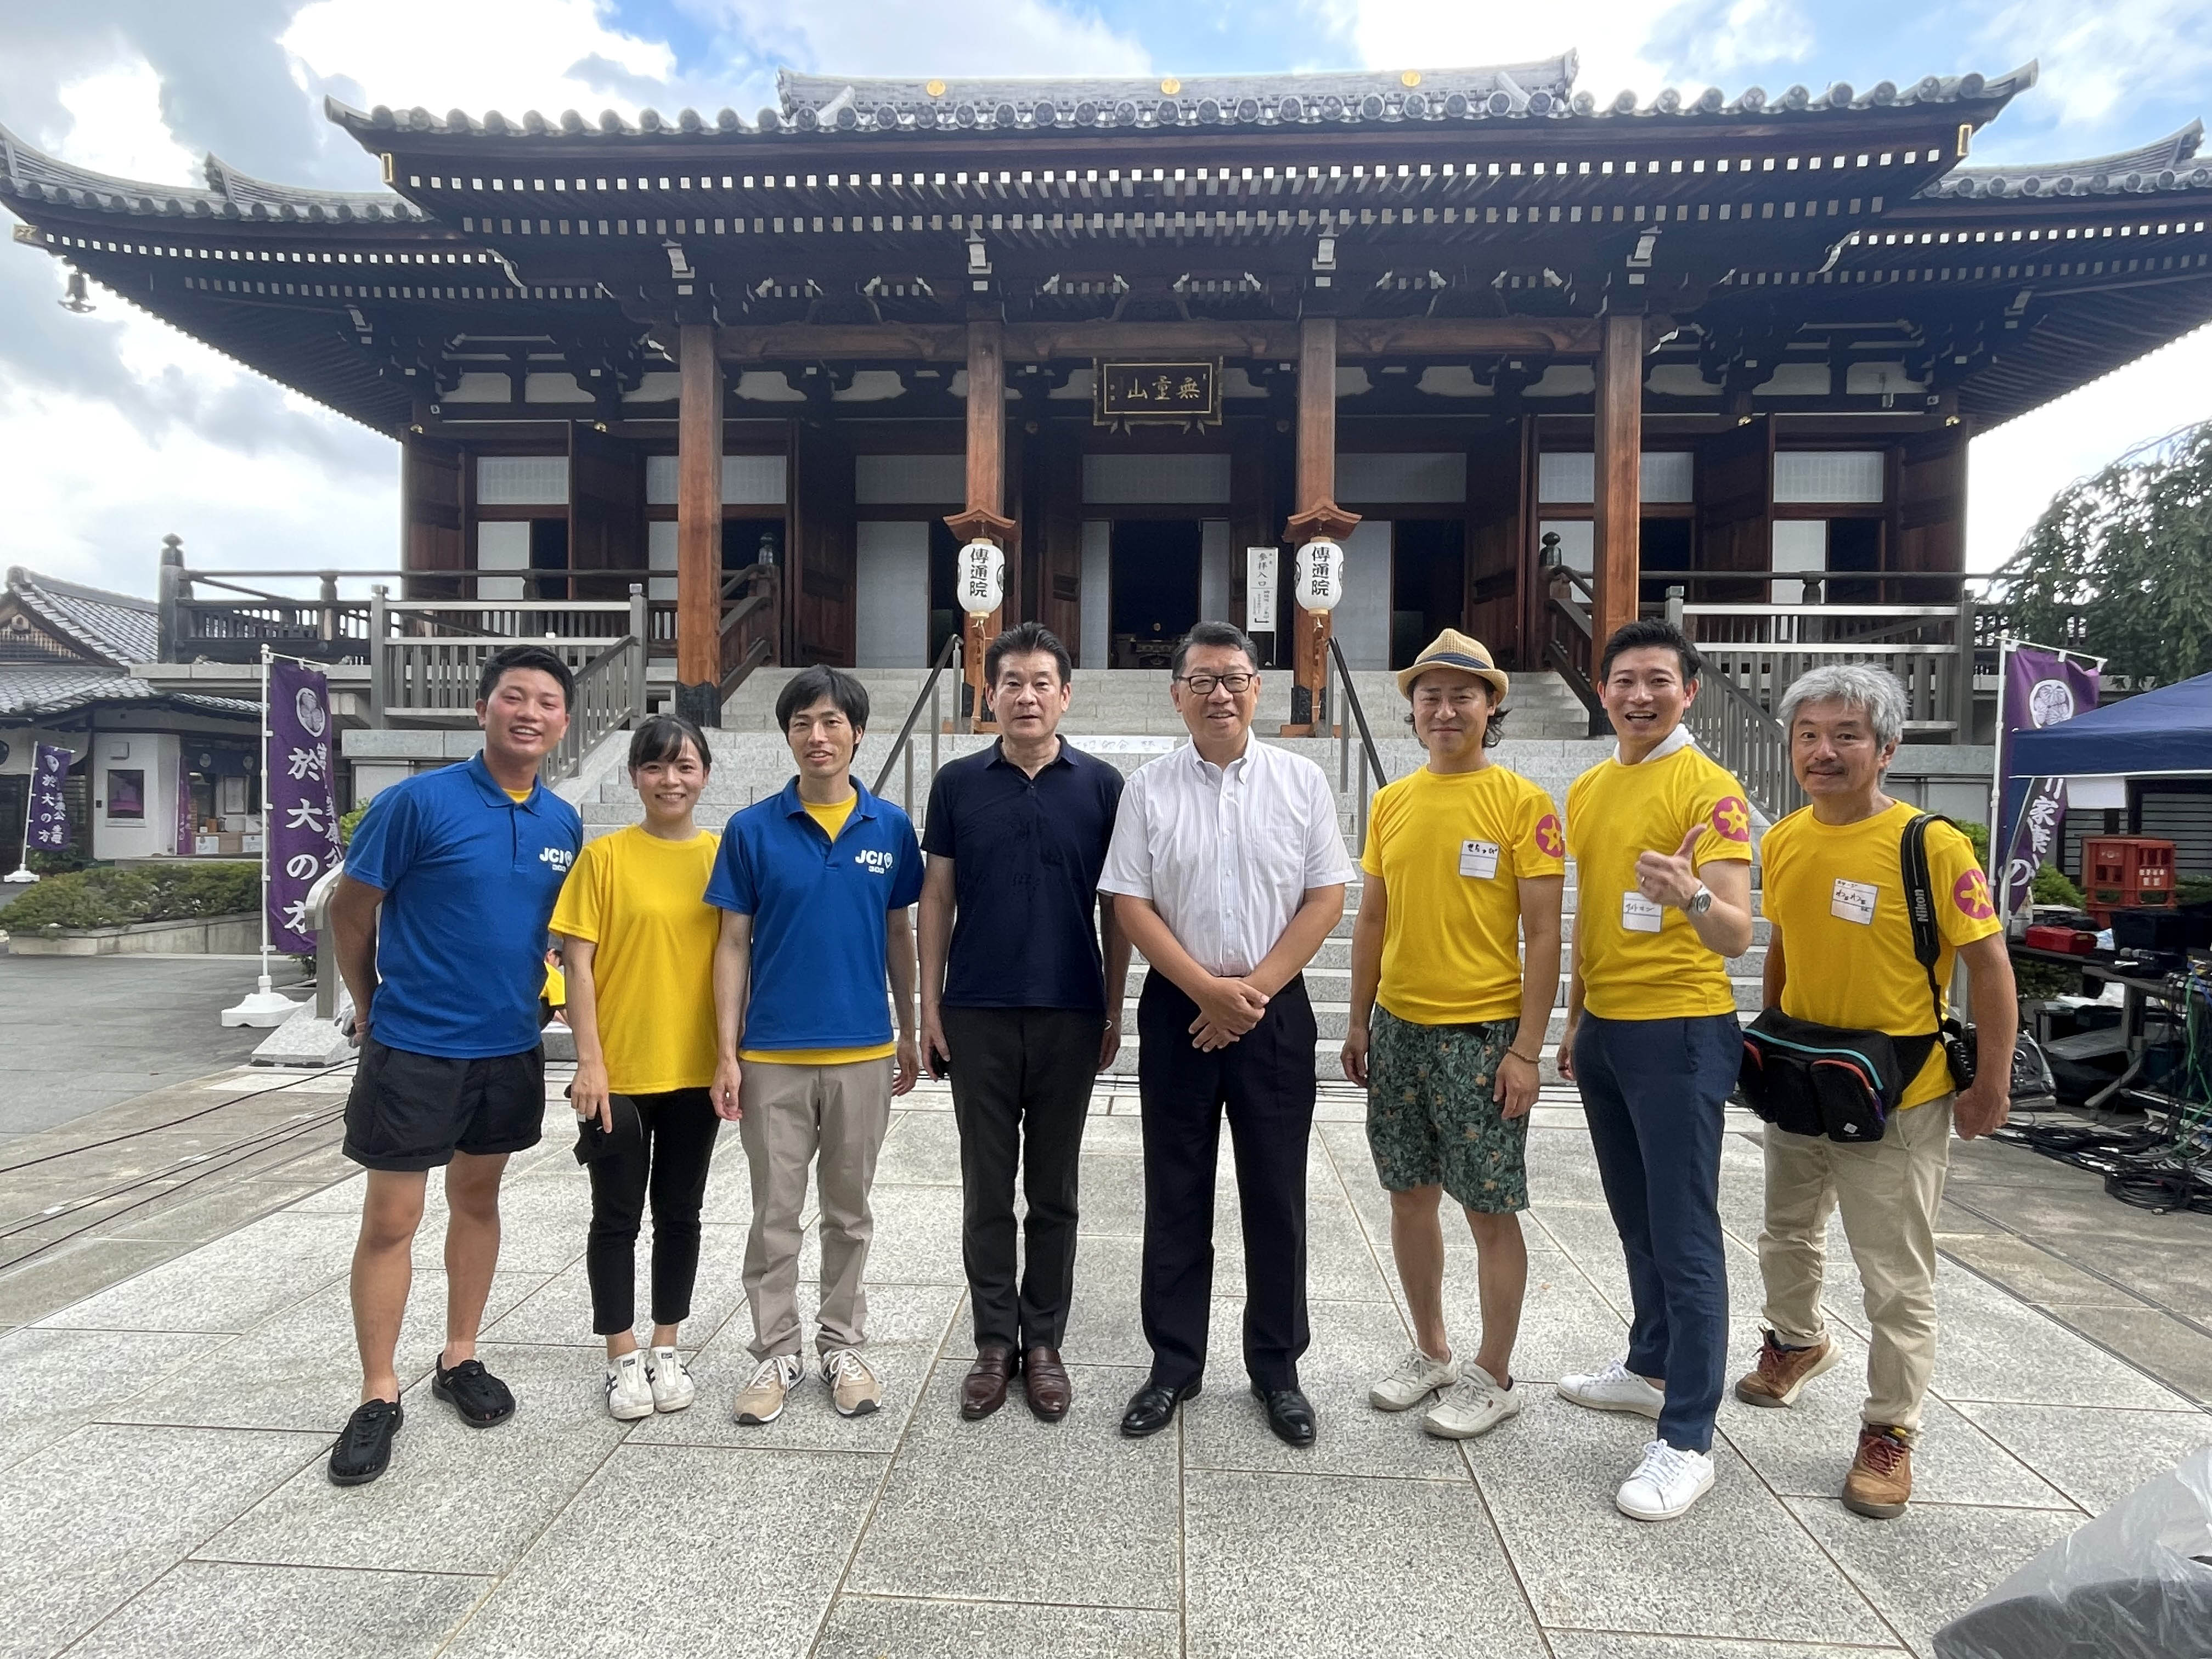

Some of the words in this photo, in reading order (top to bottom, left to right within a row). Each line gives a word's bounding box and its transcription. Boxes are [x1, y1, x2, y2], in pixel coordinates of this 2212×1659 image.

[969, 548, 989, 598] 傳通院
[1312, 546, 1330, 597] 傳通院
[38, 773, 56, 843] 於大の方
[539, 847, 564, 864] JCI
[855, 849, 883, 866] JCI
